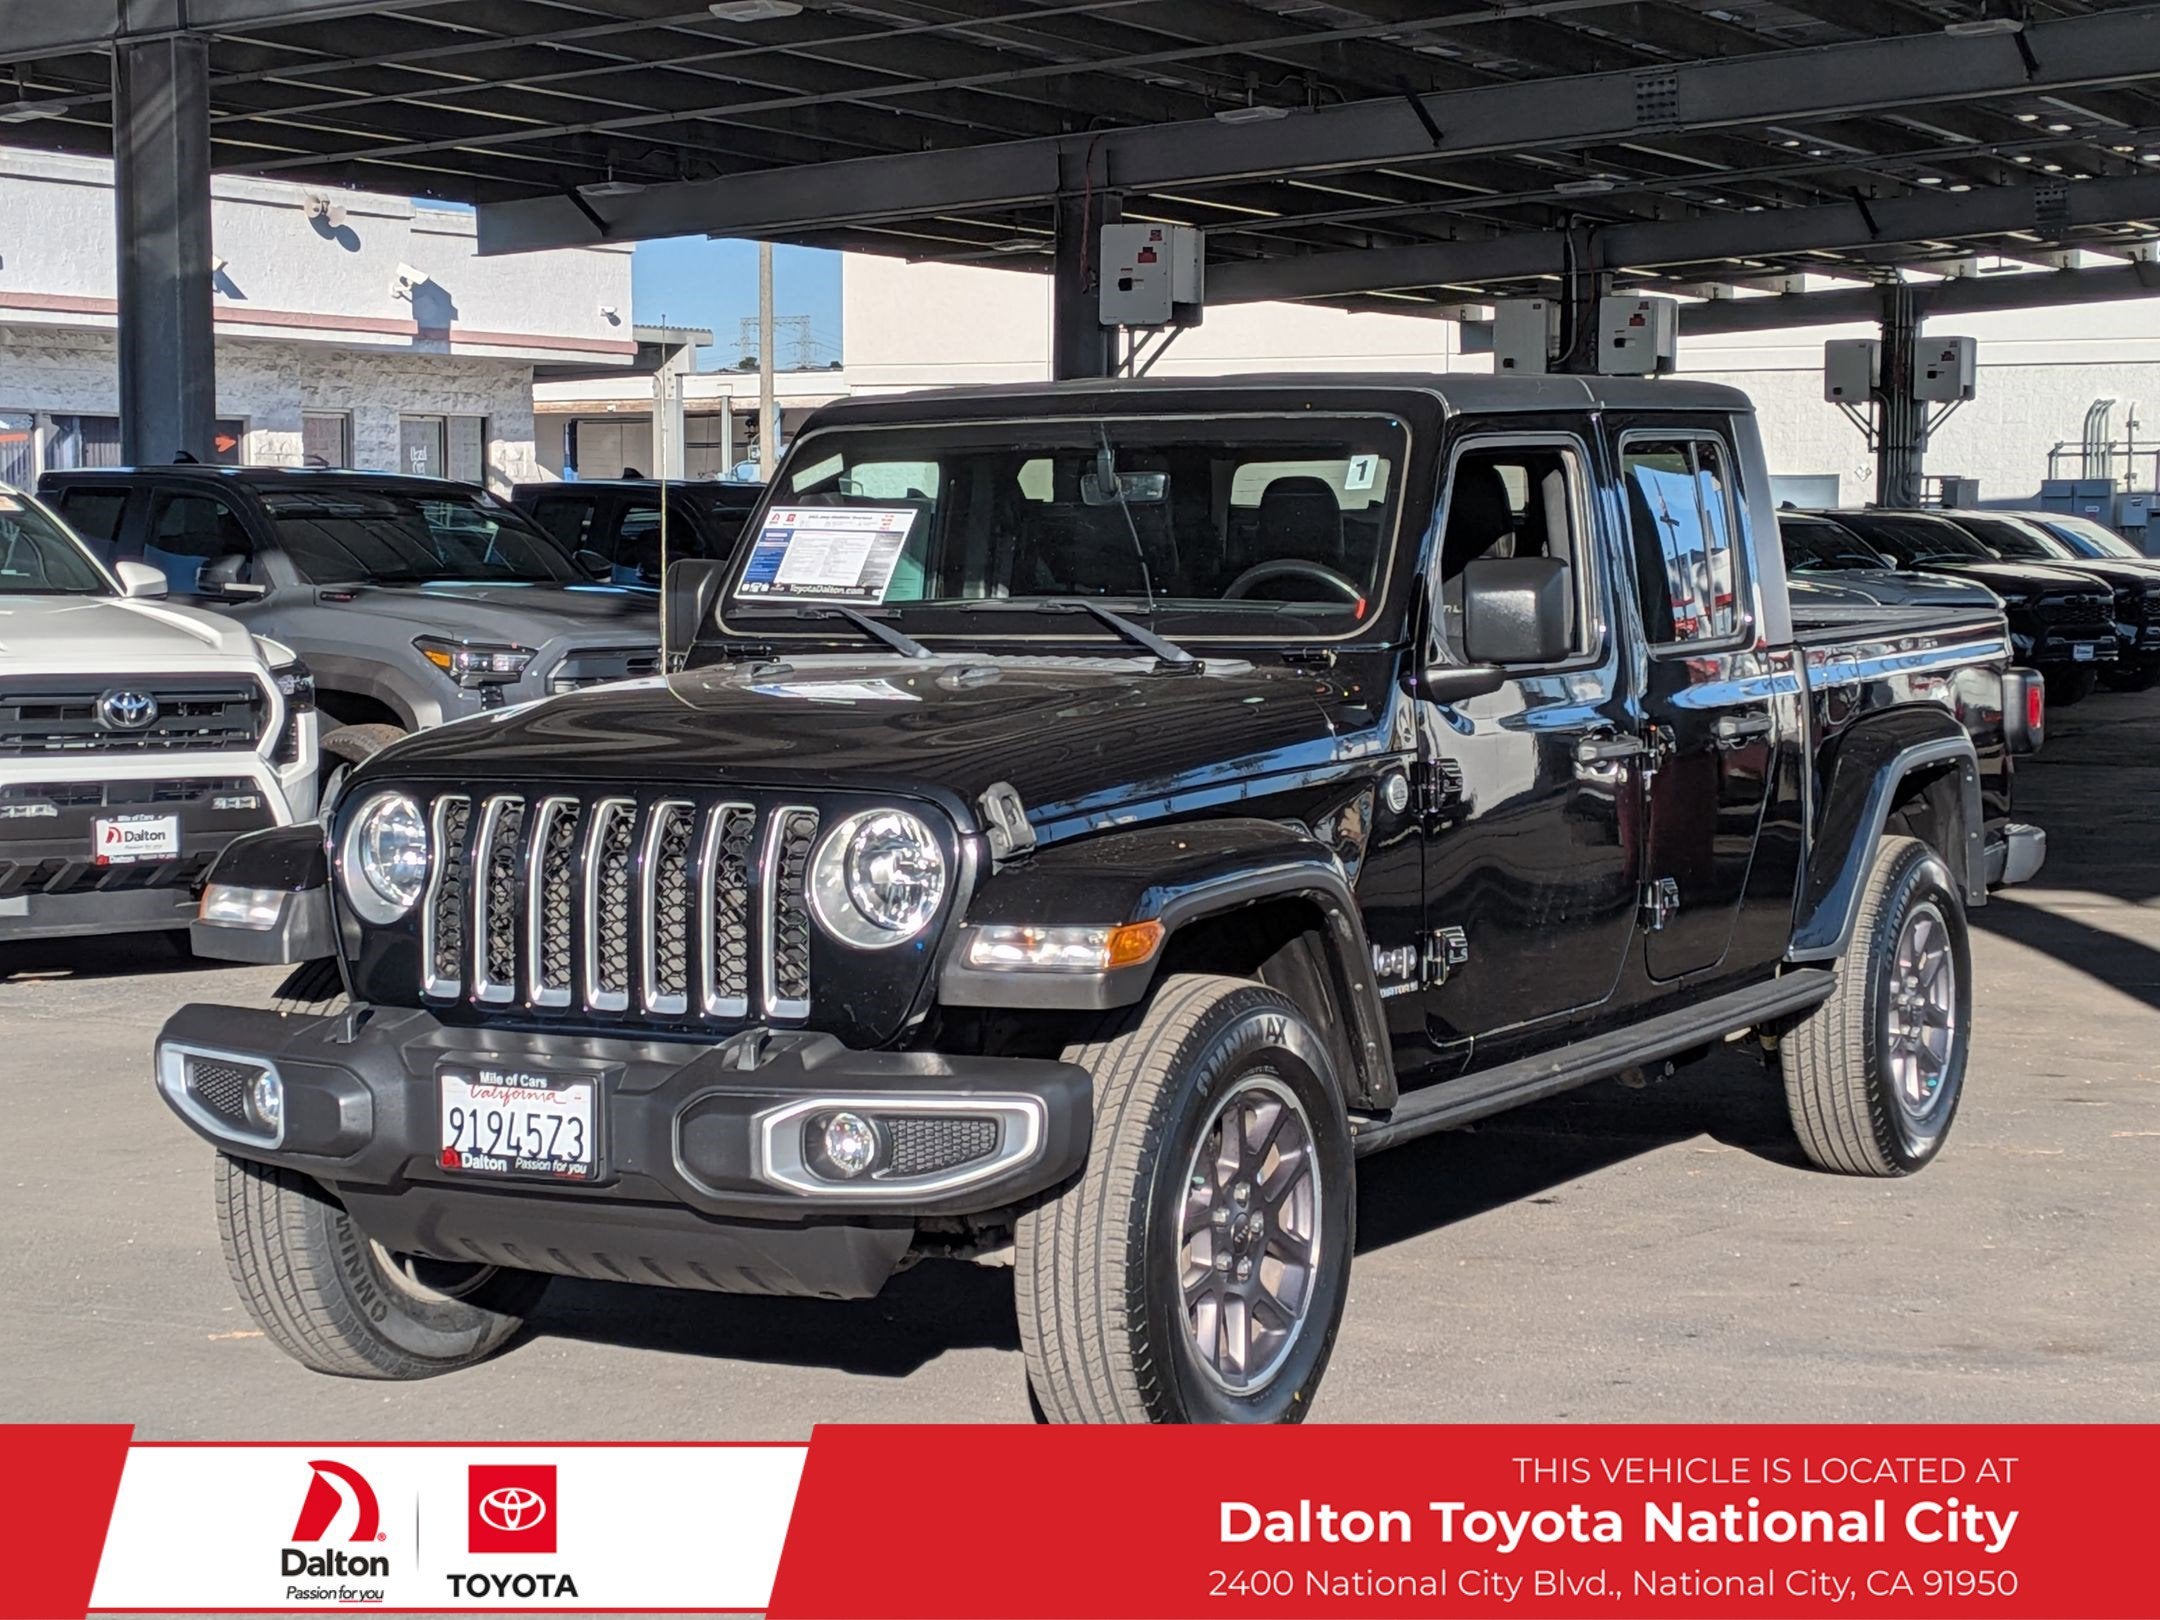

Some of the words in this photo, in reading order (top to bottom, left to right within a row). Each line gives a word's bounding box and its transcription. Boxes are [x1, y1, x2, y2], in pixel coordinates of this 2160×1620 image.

[1356, 460, 1368, 481] 1
[790, 584, 866, 595] ToyotaDalton.com
[124, 829, 166, 843] Dalton
[1373, 945, 1417, 979] Jeep
[479, 1071, 503, 1085] Mile
[505, 1073, 518, 1086] of
[520, 1074, 548, 1088] Cars
[470, 1082, 567, 1107] California
[462, 1153, 507, 1172] Dalton
[515, 1157, 551, 1171] Passion
[552, 1159, 566, 1172] for
[568, 1163, 587, 1175] you
